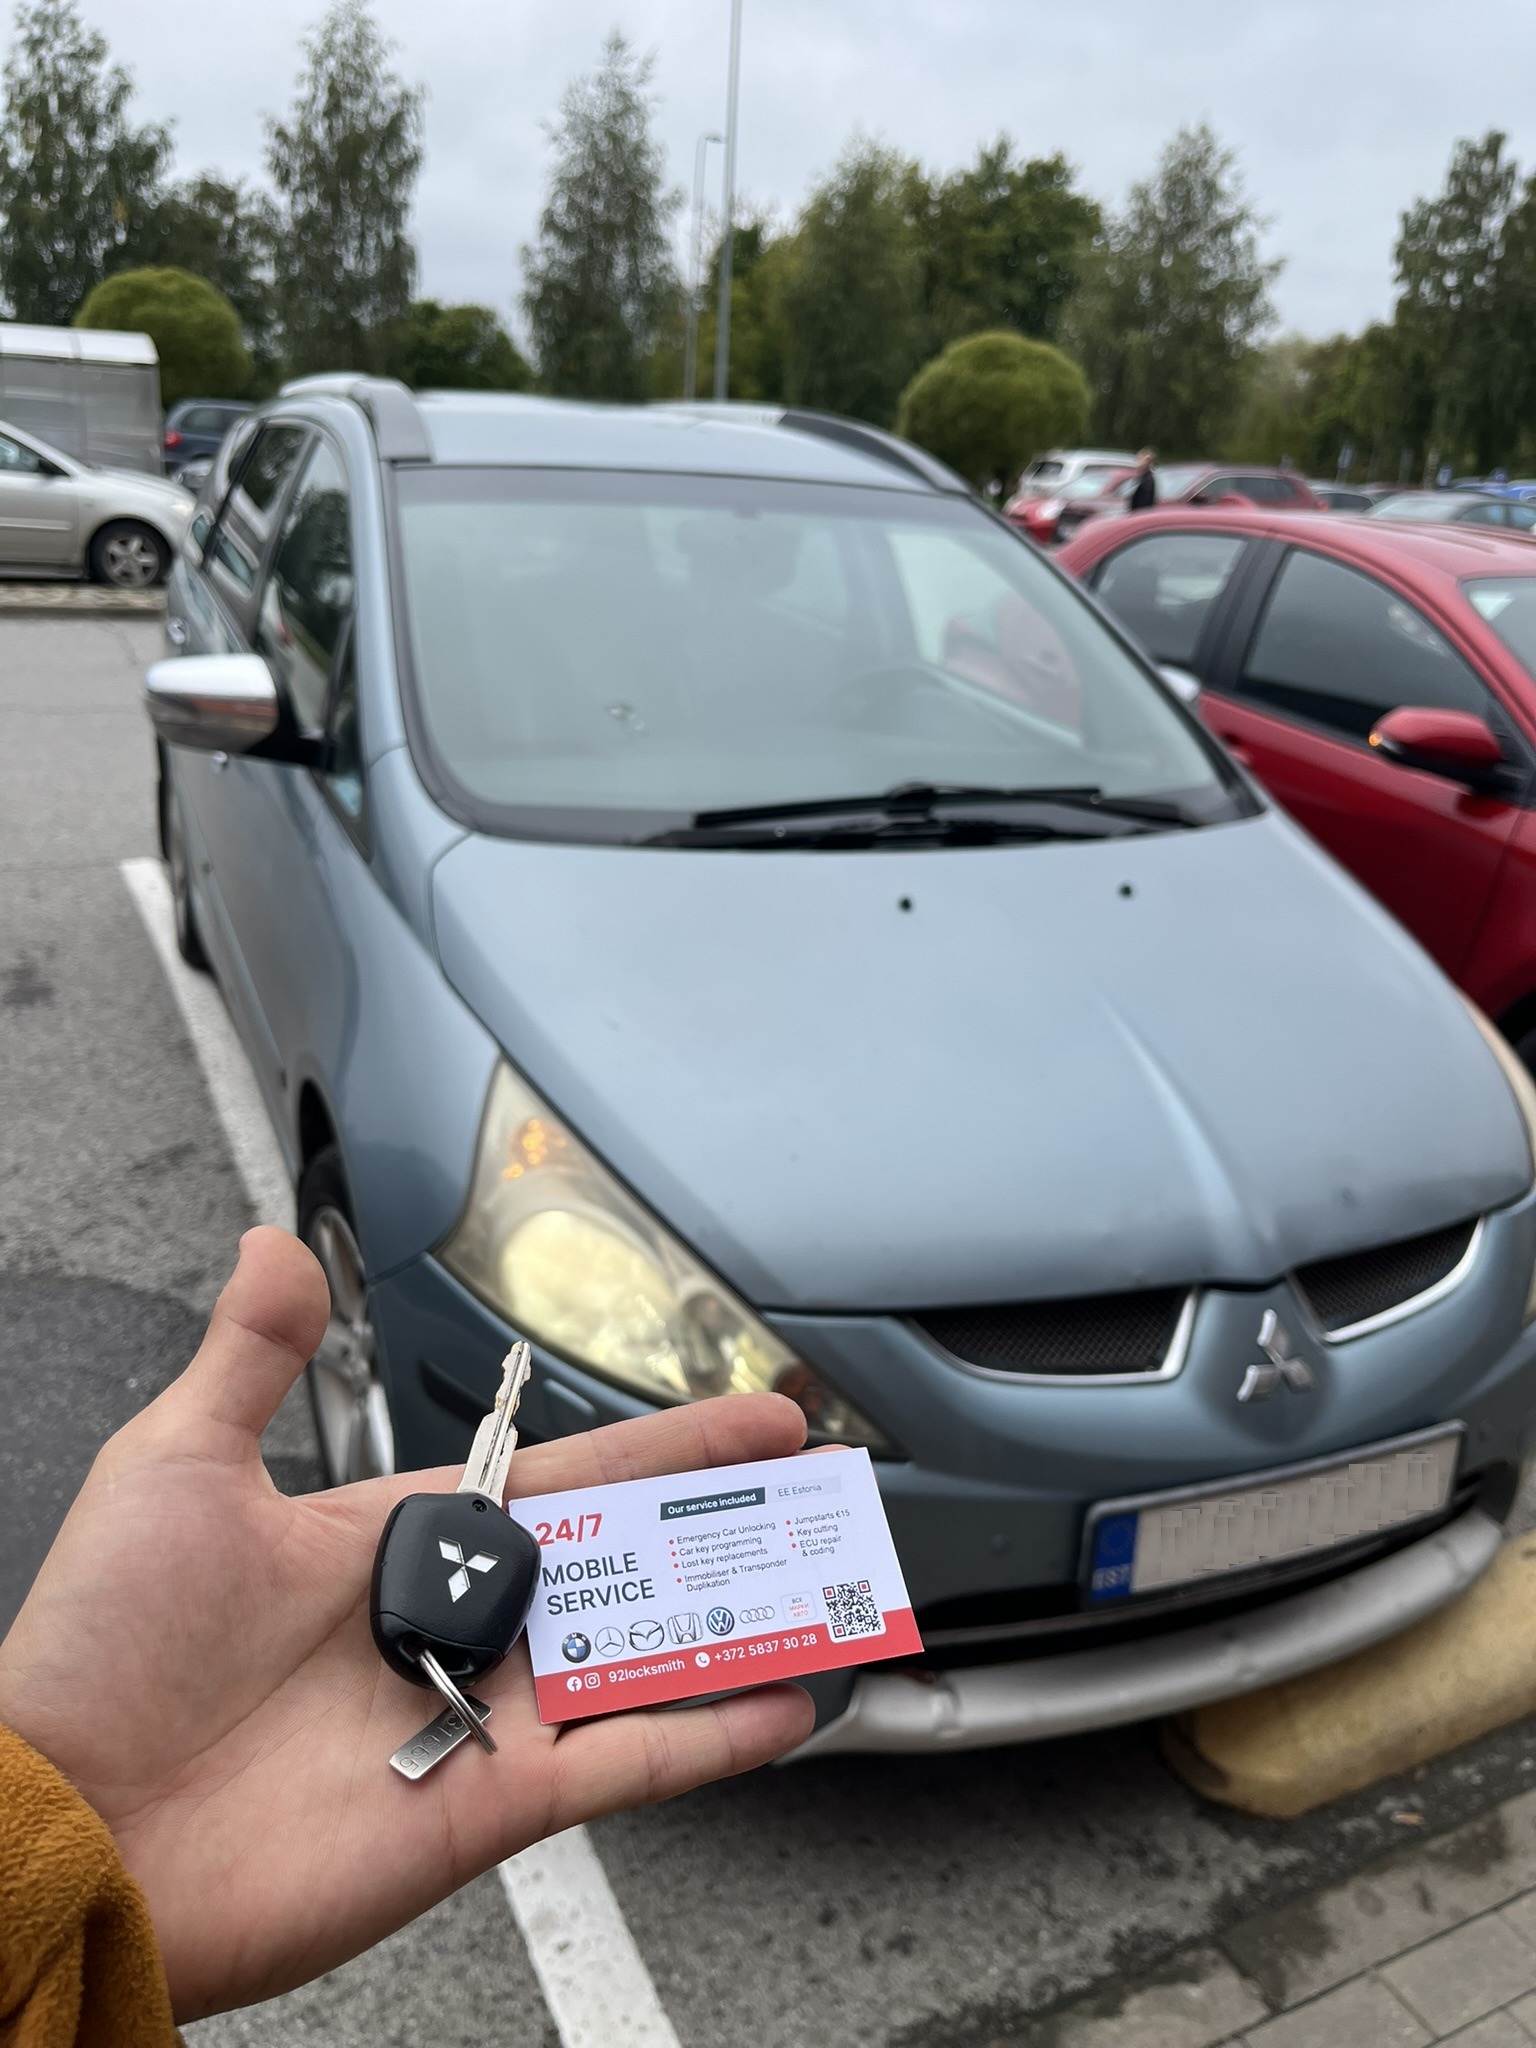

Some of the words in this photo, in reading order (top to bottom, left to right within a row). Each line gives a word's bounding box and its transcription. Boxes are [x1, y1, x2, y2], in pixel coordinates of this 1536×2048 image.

[778, 1488, 790, 1497] EE
[793, 1483, 822, 1494] Estonia
[668, 1504, 684, 1515] Our
[686, 1500, 718, 1512] service
[719, 1493, 756, 1507] included
[794, 1512, 834, 1525] Jumpstarts
[836, 1509, 850, 1518] €15
[535, 1513, 602, 1546] 24/7
[677, 1530, 720, 1544] Emergency
[723, 1528, 736, 1536] Car
[738, 1522, 776, 1534] Unlocking
[797, 1528, 812, 1538] Key
[814, 1524, 838, 1534] cutting
[680, 1548, 694, 1556] Car
[696, 1546, 709, 1555] key
[712, 1536, 762, 1552] programming
[800, 1540, 818, 1548] ECU
[820, 1535, 841, 1546] repair
[810, 1546, 835, 1556] coding
[682, 1558, 699, 1568] Lost
[701, 1556, 714, 1566] key
[716, 1548, 768, 1563] replacements
[542, 1552, 638, 1586] MOBILE
[685, 1569, 729, 1582] Immobiliser
[739, 1559, 788, 1574] Transponder
[687, 1578, 730, 1592] Duplikation
[546, 1578, 656, 1616] SERVICE
[715, 1646, 746, 1662] +372
[749, 1640, 779, 1657] 5837
[783, 1636, 798, 1650] 30
[801, 1633, 818, 1646] 28
[608, 1659, 685, 1683] 92locksmith
